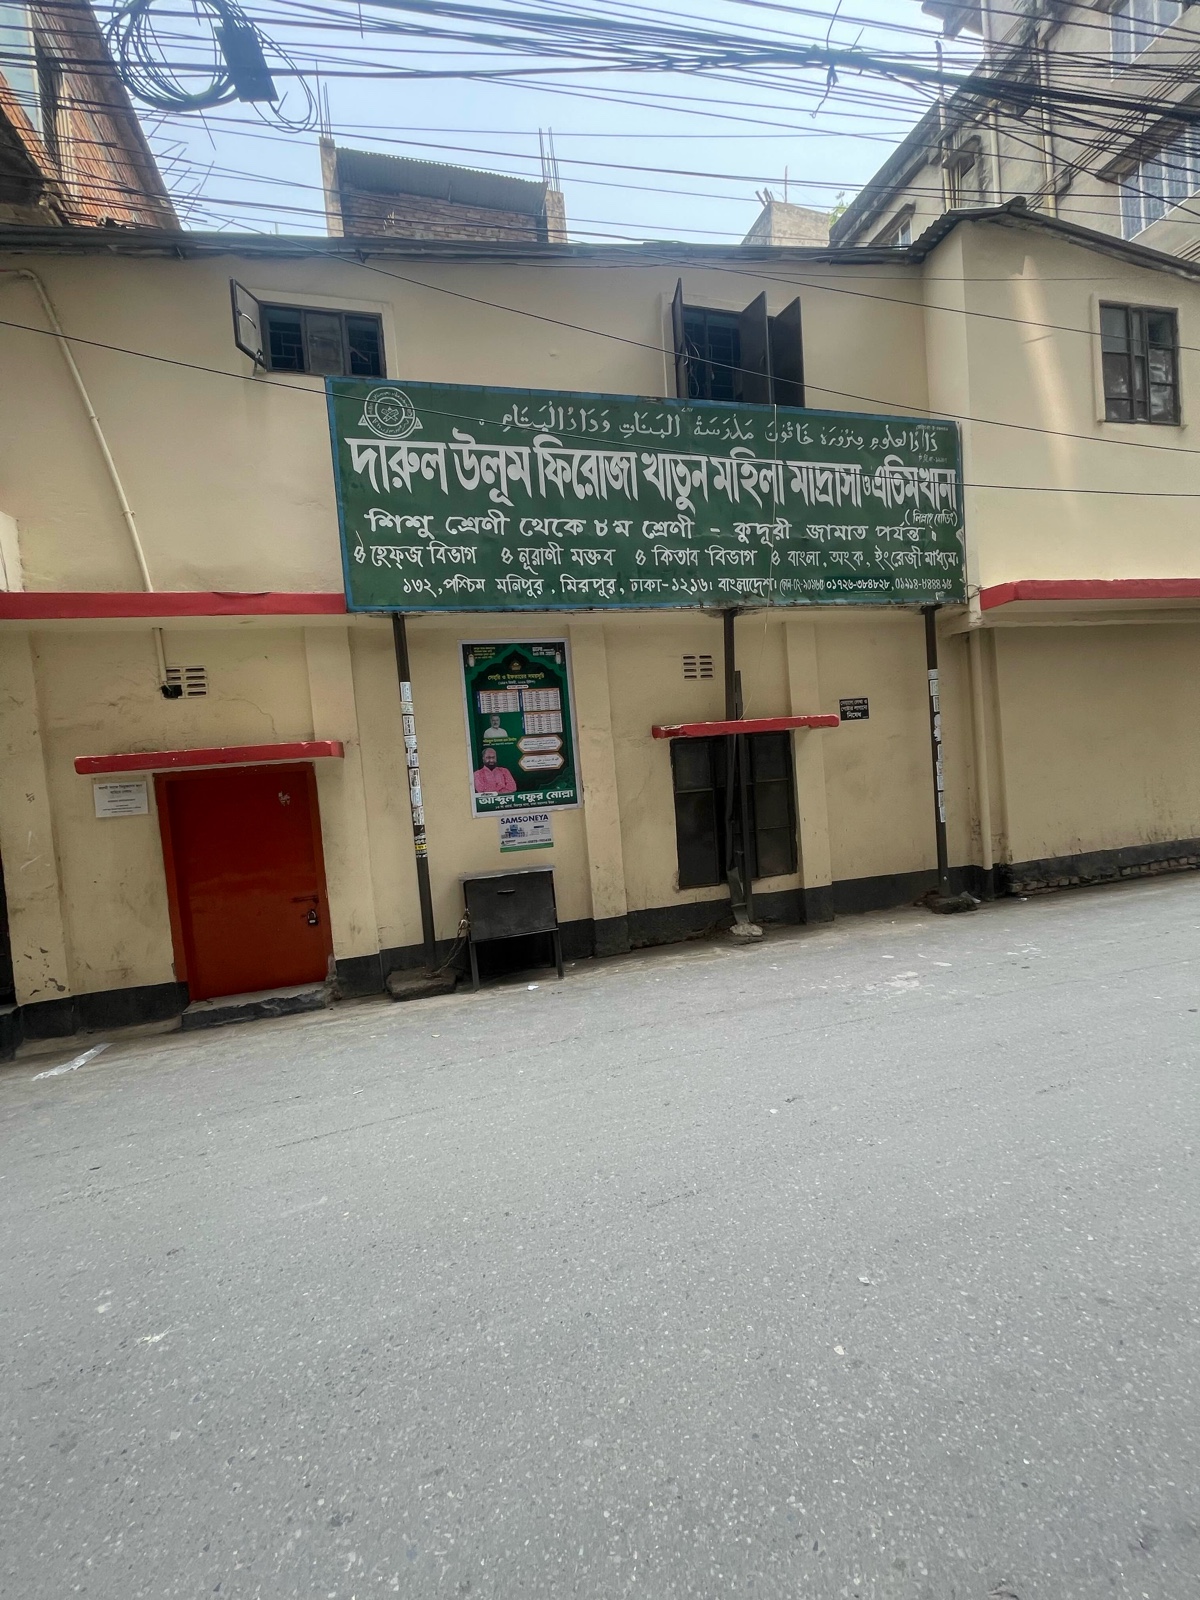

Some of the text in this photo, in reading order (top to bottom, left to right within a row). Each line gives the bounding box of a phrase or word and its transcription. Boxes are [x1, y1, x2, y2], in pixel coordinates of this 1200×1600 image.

[344, 437, 448, 495] দারুল
[533, 434, 638, 501] ফিরোজা
[641, 453, 709, 516] খাতুন
[709, 447, 785, 510] মহিলা
[786, 461, 863, 508] মাদ্রাসা
[872, 454, 957, 511] এতিমখানা
[363, 508, 435, 540] শিশু
[445, 509, 511, 536] শ্রেণী
[519, 518, 587, 537] থেকে
[642, 513, 695, 539] শ্রেণী
[806, 523, 869, 542] জামাত
[426, 540, 477, 564] বিভাগ
[570, 549, 616, 566] মক্তব
[651, 544, 700, 566] কিতাব
[705, 544, 758, 566] বিভাগ
[874, 545, 923, 571] ইংরেজী
[518, 792, 543, 803] গফুর
[501, 814, 549, 825] SAMSONEYA
